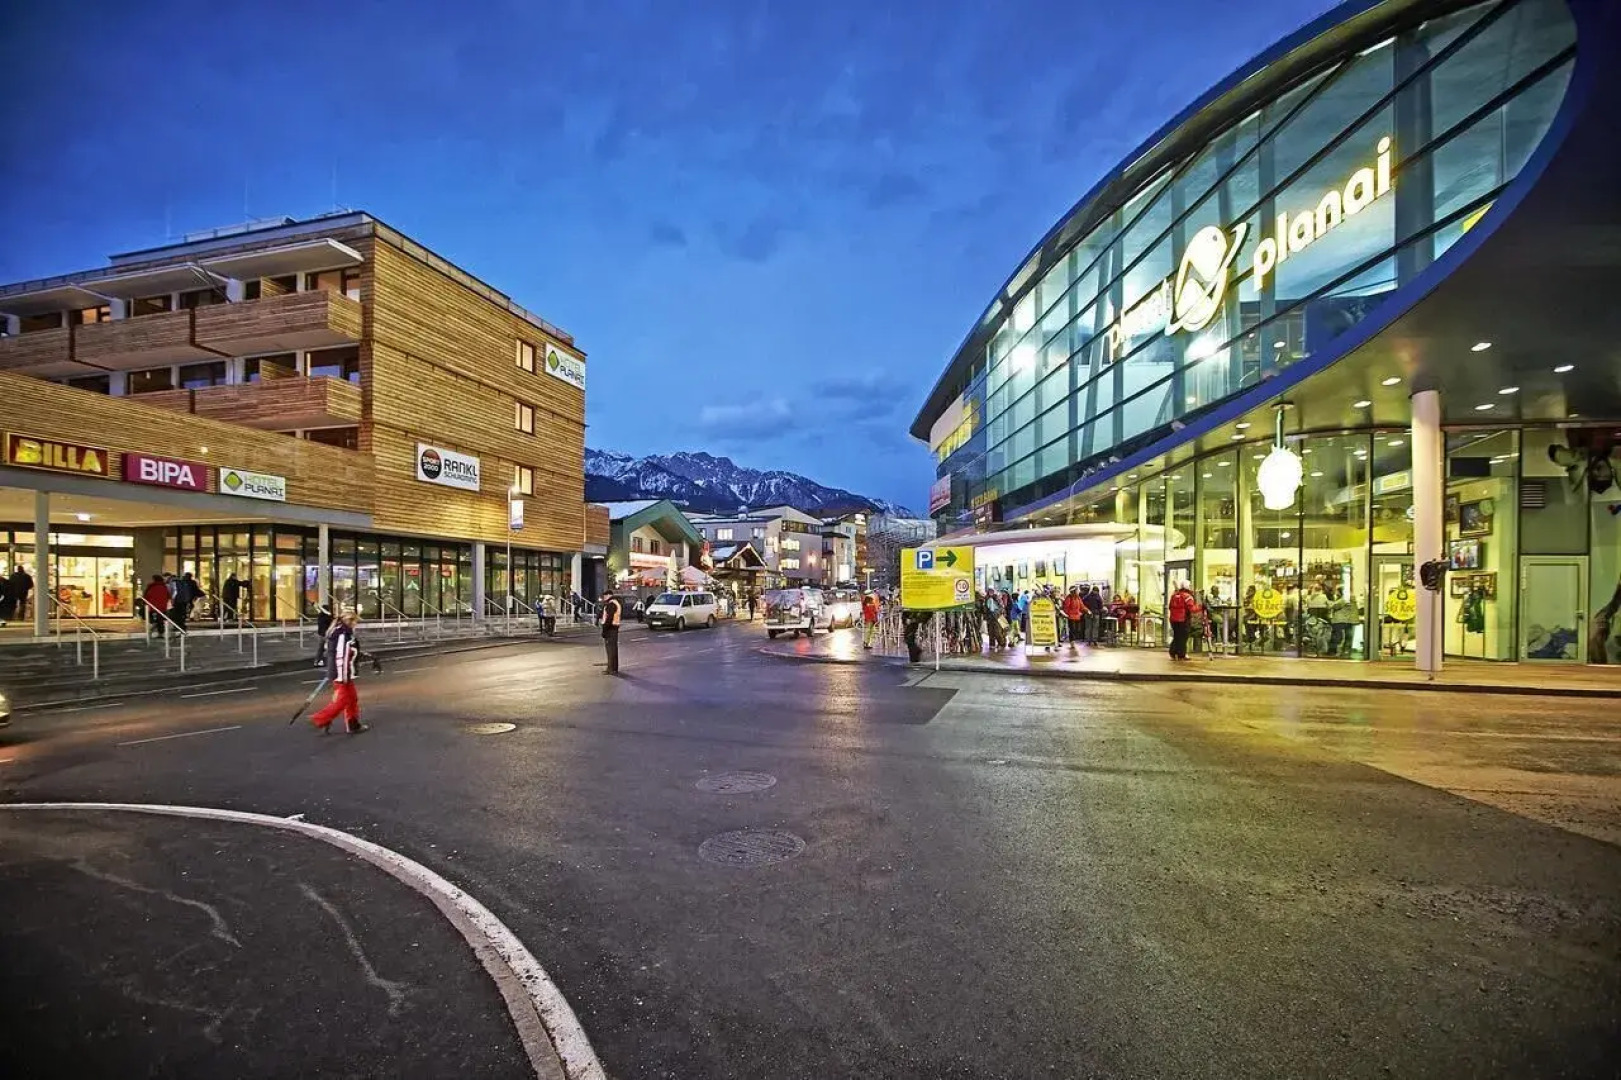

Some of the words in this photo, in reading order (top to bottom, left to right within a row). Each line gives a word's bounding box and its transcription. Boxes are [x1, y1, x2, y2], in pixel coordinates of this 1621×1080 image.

[1253, 136, 1391, 293] planai
[15, 439, 101, 473] BILLA
[444, 459, 477, 476] RANKL
[140, 458, 196, 487] BIPA
[245, 484, 283, 496] PLANAI
[919, 552, 931, 568] P
